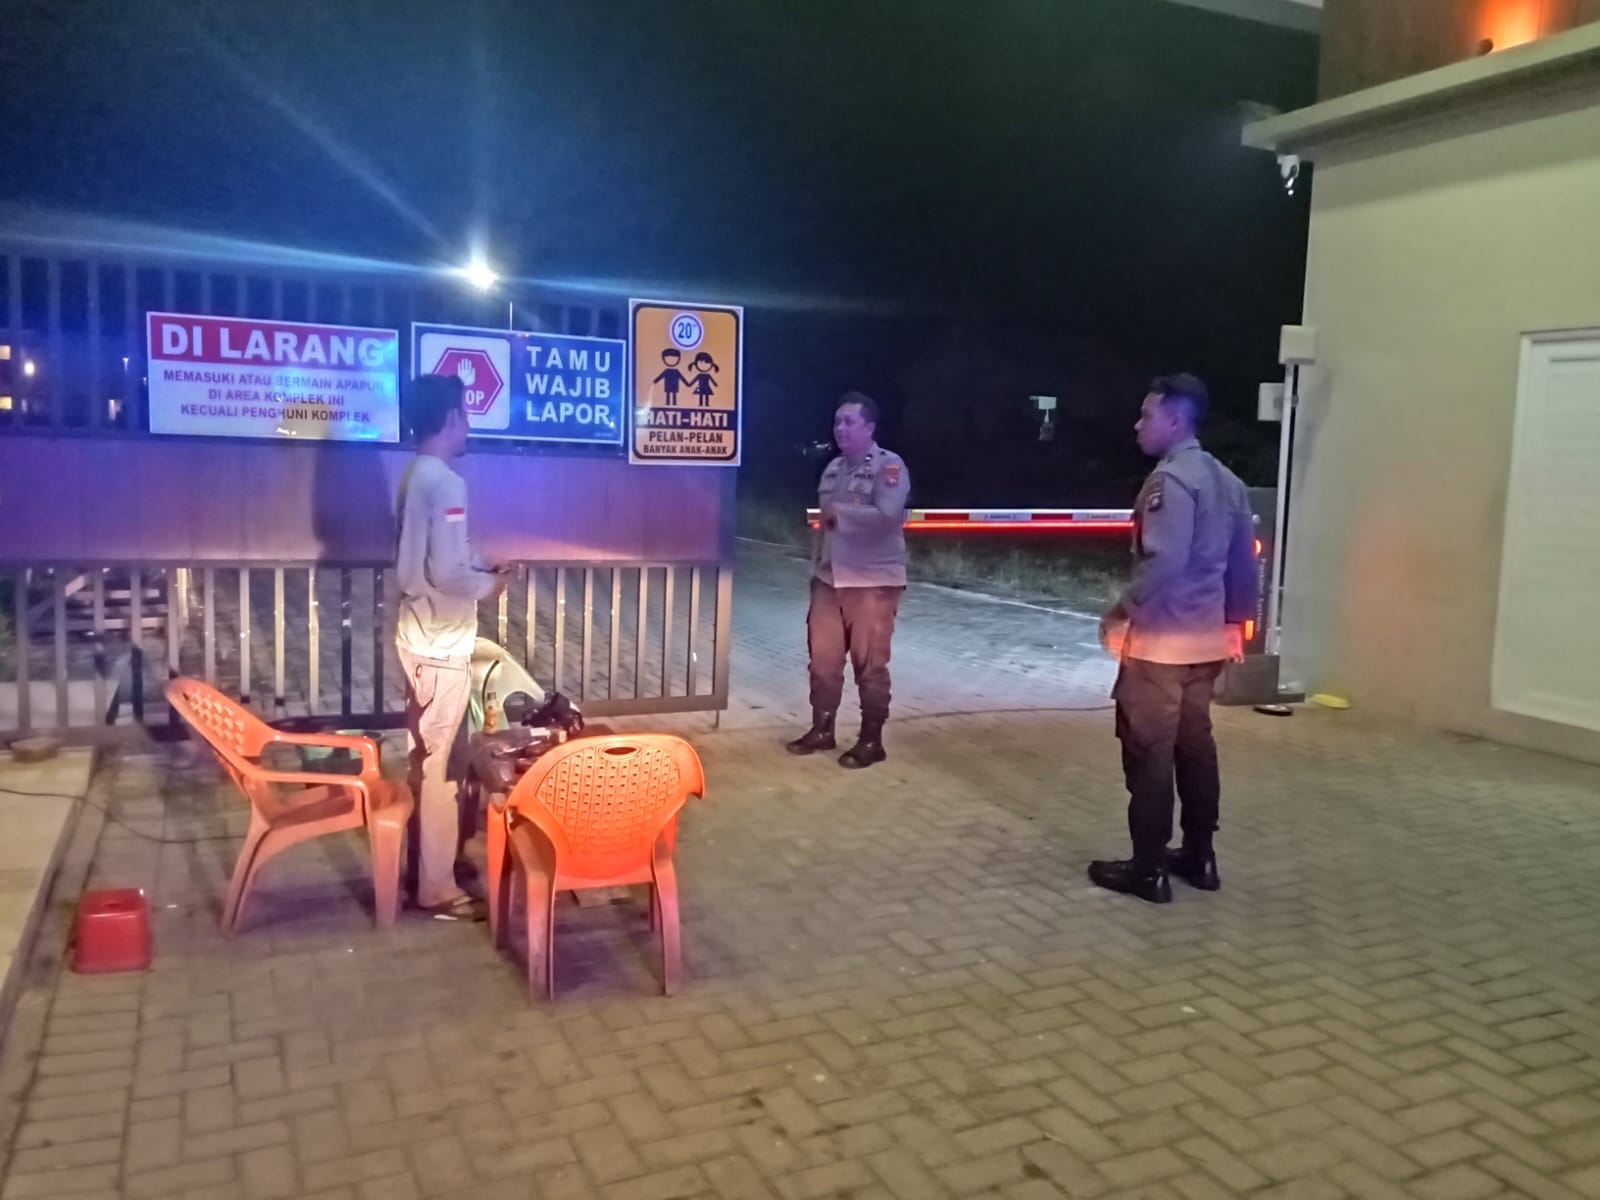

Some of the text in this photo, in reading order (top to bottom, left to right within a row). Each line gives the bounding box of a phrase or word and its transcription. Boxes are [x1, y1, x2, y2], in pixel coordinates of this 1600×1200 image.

[161, 323, 384, 367] DI LARANG
[526, 346, 610, 373] TAMU
[163, 369, 383, 392] MEMASUKI ATAU BERMAIN APAPUN
[526, 373, 610, 399] WAJIB
[208, 389, 344, 406] DI AREA KOMPLEK INI
[465, 390, 485, 405] OP
[181, 404, 370, 423] KECUALI PENGHUNI KOMPLEK
[526, 401, 610, 425] LAPOR
[643, 410, 728, 427] HATI-HATI
[649, 431, 723, 443] PELAN-PELAN
[643, 444, 728, 455] BANYAK ANAK-ANAK
